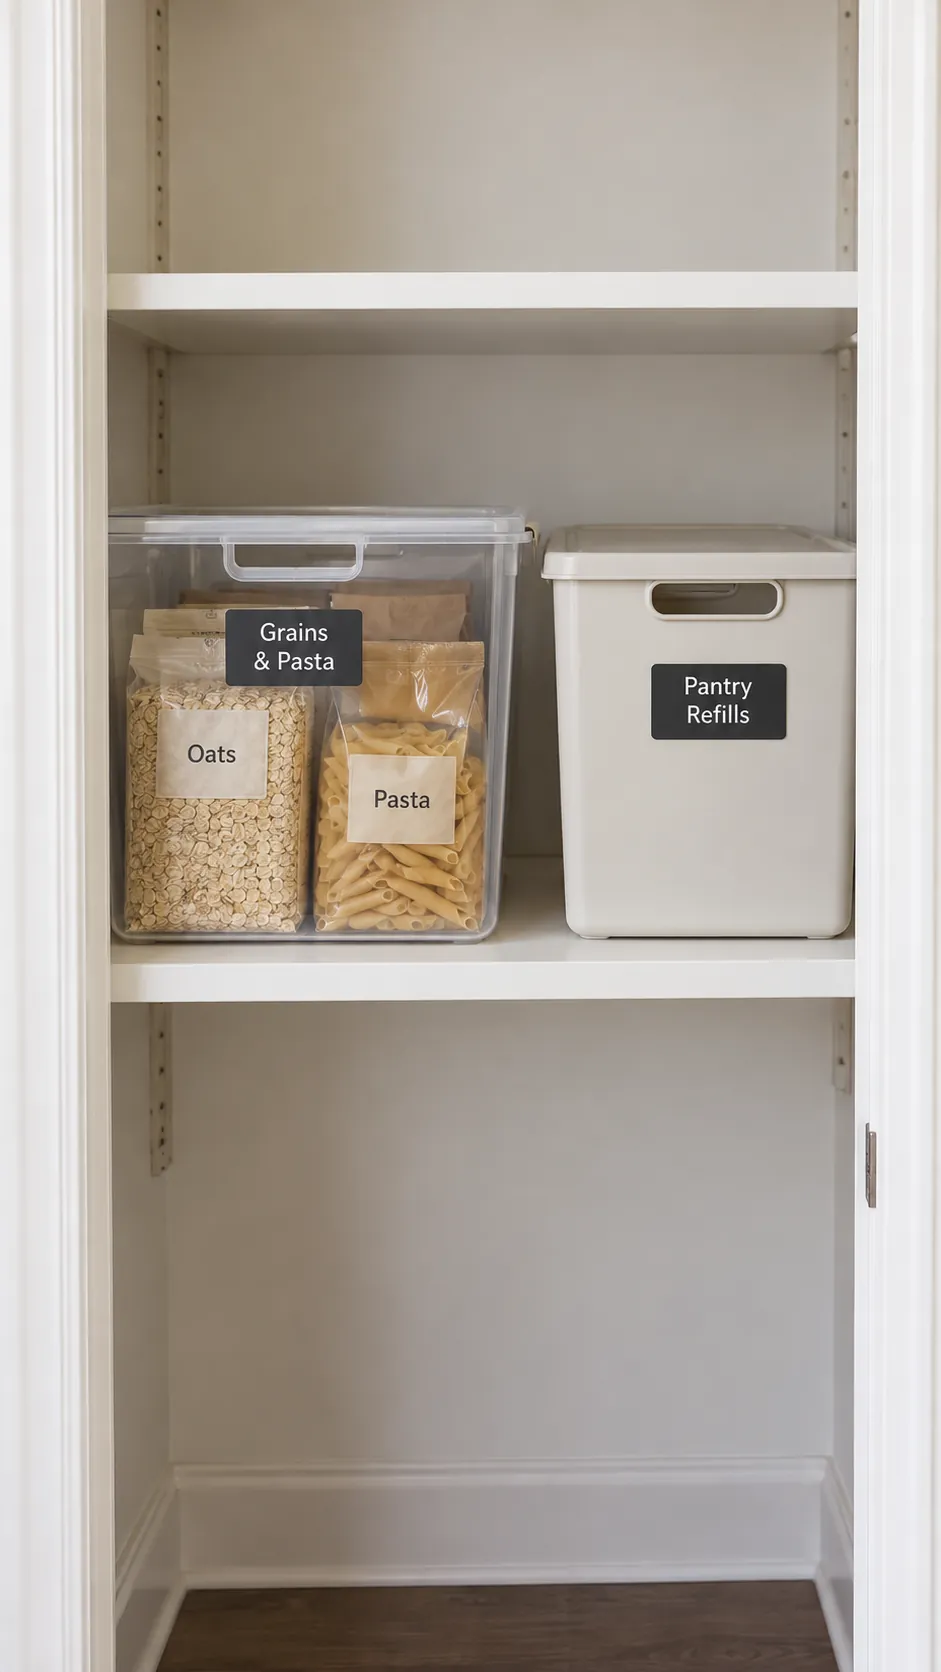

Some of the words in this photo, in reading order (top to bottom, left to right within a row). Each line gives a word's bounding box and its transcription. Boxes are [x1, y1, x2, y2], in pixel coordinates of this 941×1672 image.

[260, 622, 328, 642] Grains
[253, 650, 271, 671] &
[278, 650, 335, 671] Pasta
[685, 676, 753, 700] Pantry
[687, 703, 750, 724] Refills
[187, 744, 236, 764] Oats
[374, 789, 430, 809] Pasta
